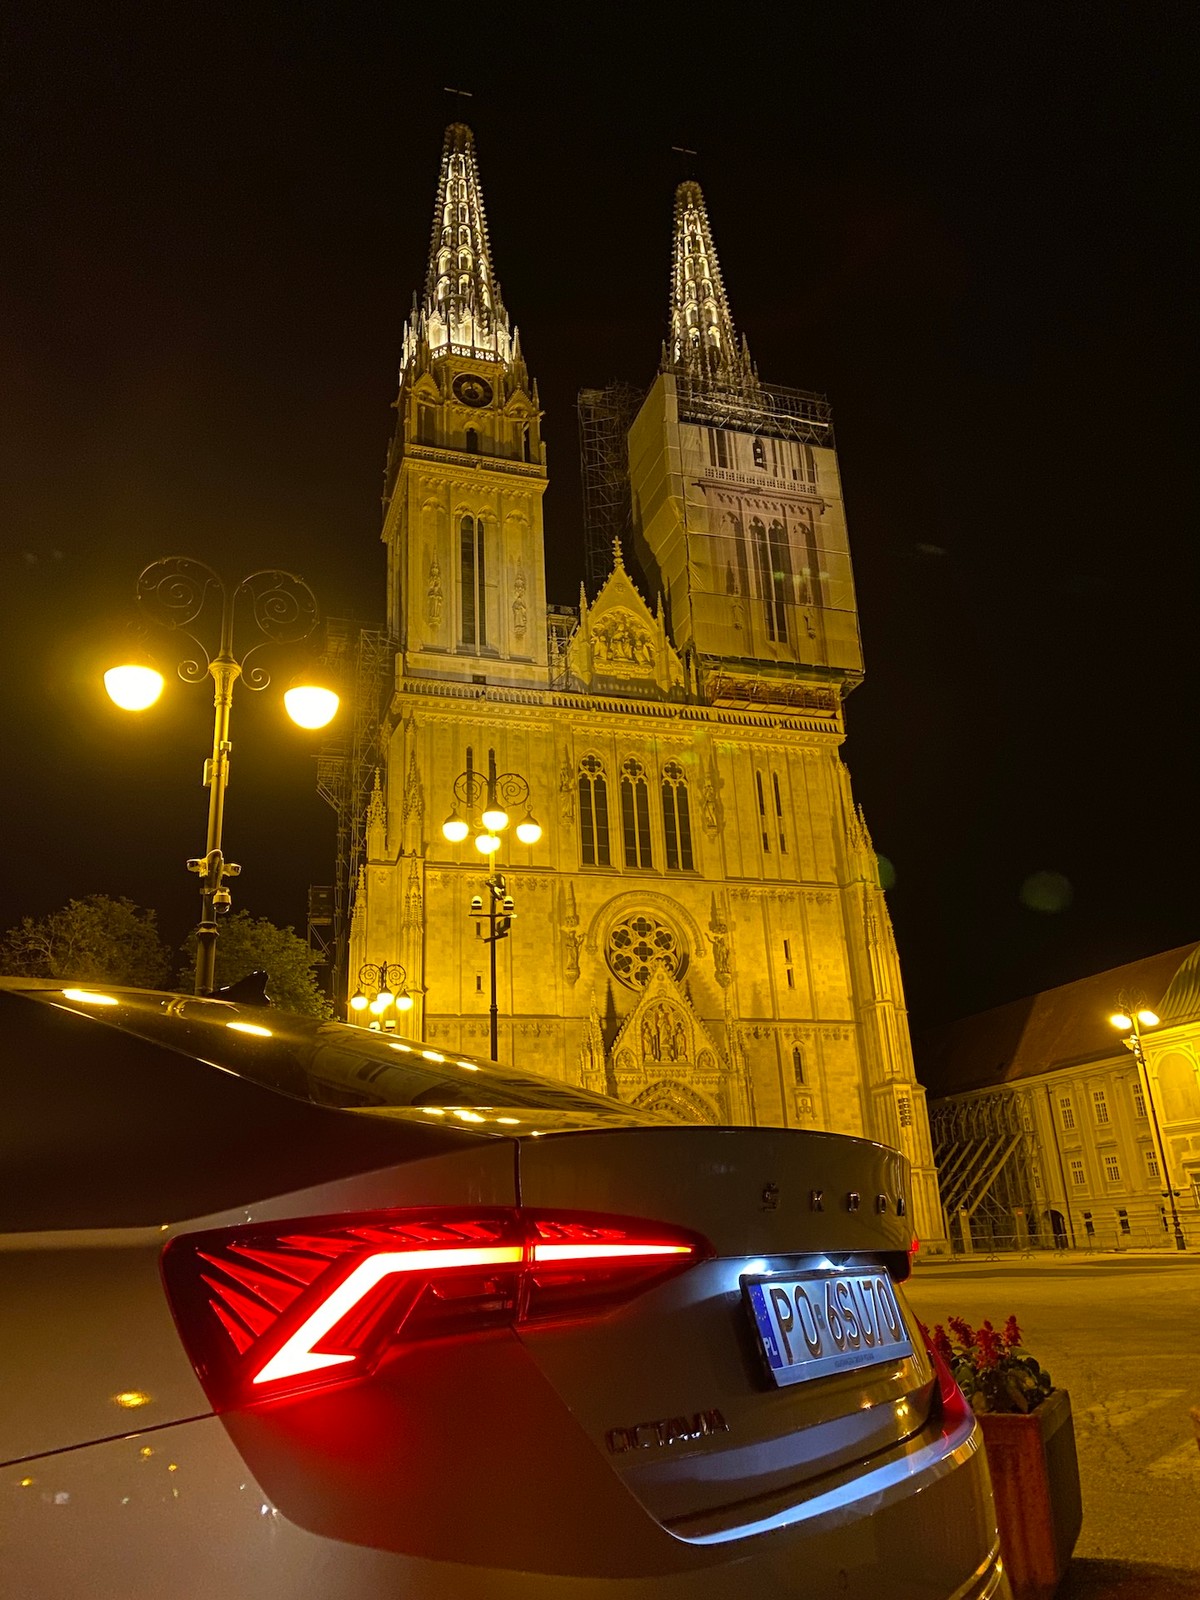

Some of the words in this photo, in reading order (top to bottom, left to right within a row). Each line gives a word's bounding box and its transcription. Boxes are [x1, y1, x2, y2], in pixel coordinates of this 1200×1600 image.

[763, 1336, 778, 1358] PL
[770, 1285, 823, 1365] PO
[824, 1277, 902, 1352] 6SU70
